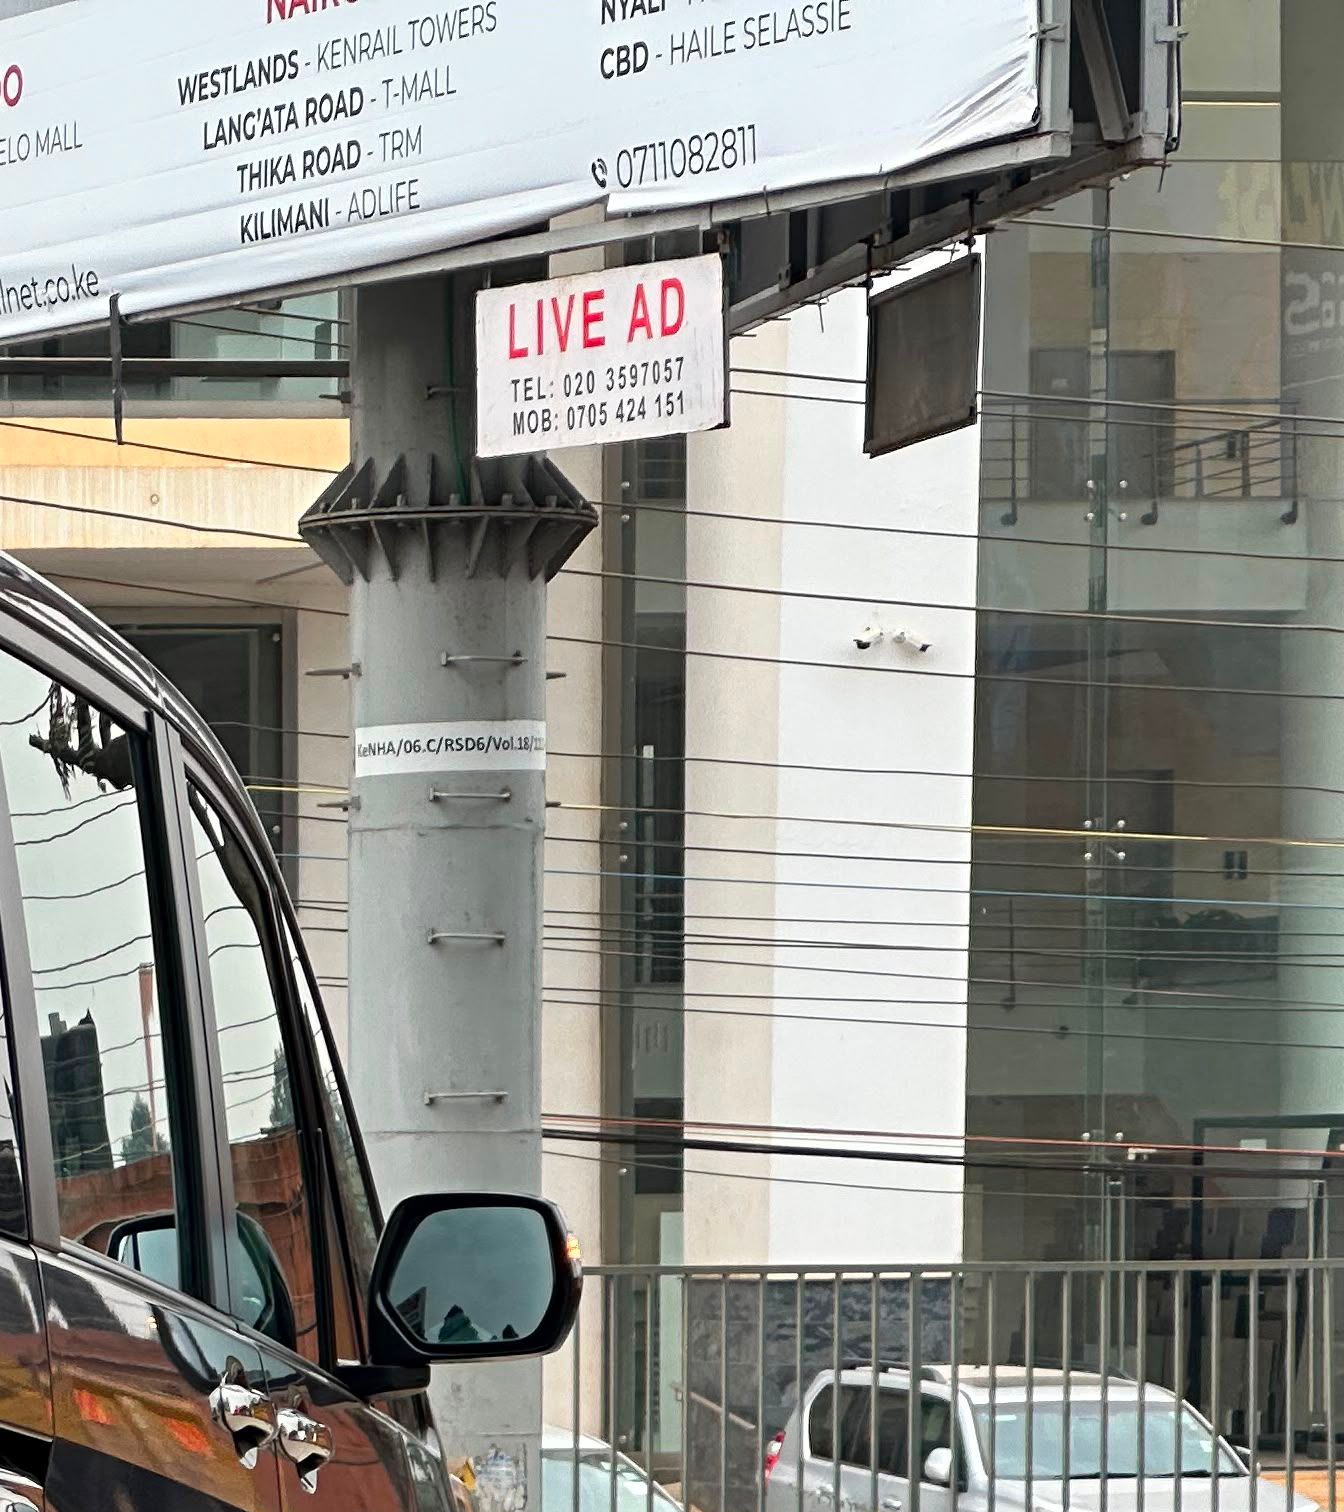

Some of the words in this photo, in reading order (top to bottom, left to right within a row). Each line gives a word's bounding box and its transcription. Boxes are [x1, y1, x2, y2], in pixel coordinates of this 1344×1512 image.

[178, 50, 300, 105] WESTLANDS
[316, 25, 403, 73] KENRAIL
[408, 1, 498, 50] TOWERS
[599, 41, 650, 80] CBD
[670, 21, 737, 66] HAILE
[743, 0, 851, 50] SELASSIE
[35, 122, 83, 157] MALL
[203, 93, 301, 151] LANG'ATA
[305, 85, 365, 132] ROAD
[382, 65, 458, 109] T-MALL
[237, 150, 298, 194] THIKA
[302, 139, 362, 179] ROAD
[378, 125, 424, 160] TRM
[616, 125, 758, 189] 0711082811
[239, 197, 331, 245] KILIMANI
[347, 179, 421, 223] ADLIFE
[507, 289, 607, 360] LIVE
[627, 277, 687, 344] AD
[511, 373, 555, 404] TEL:
[563, 369, 597, 398] 020
[605, 356, 686, 392] 3597057
[513, 406, 560, 437] MOB:
[566, 400, 608, 431] 0705
[615, 394, 648, 423] 424
[654, 390, 686, 418] 151
